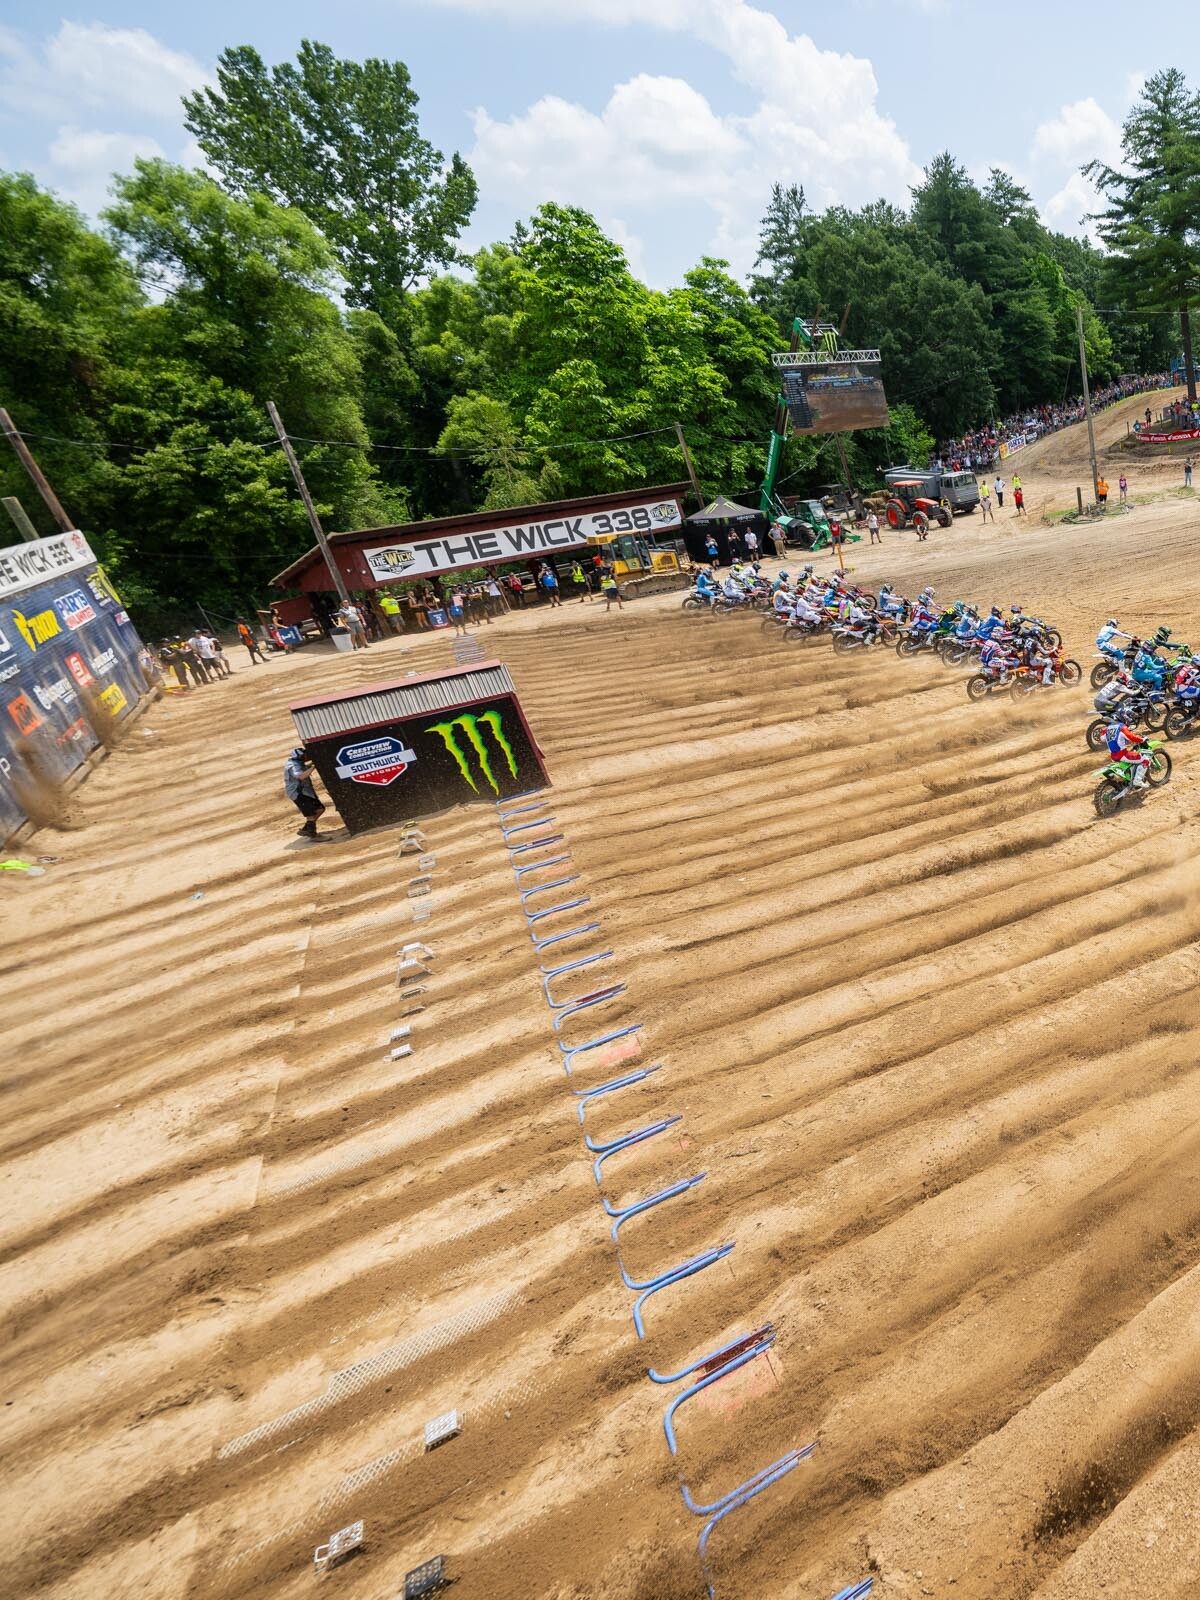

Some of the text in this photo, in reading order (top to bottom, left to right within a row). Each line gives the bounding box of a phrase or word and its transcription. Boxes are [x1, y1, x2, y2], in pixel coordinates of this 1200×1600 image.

[413, 508, 652, 567] THE WICK 338
[12, 548, 55, 577] WICK
[369, 551, 414, 567] THE WICK
[346, 741, 391, 756] CRESTVIEW
[351, 754, 402, 773] SOUTHWICK
[359, 765, 402, 779] NATIONAL
